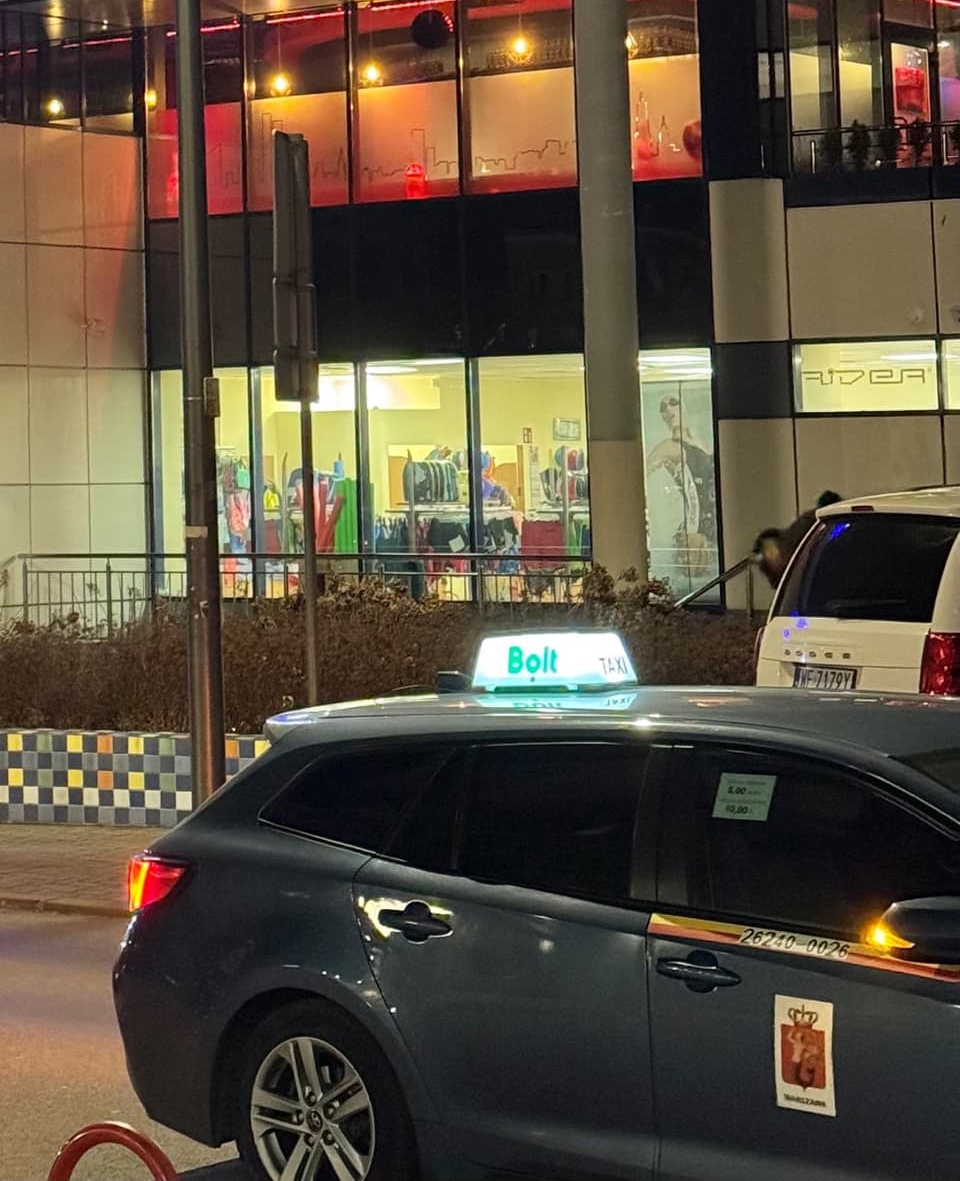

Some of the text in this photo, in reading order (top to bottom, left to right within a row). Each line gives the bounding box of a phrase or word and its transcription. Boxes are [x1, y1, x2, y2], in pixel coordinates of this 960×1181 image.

[507, 646, 629, 676] Bolt TAXI
[740, 928, 850, 957] 26240-0026
